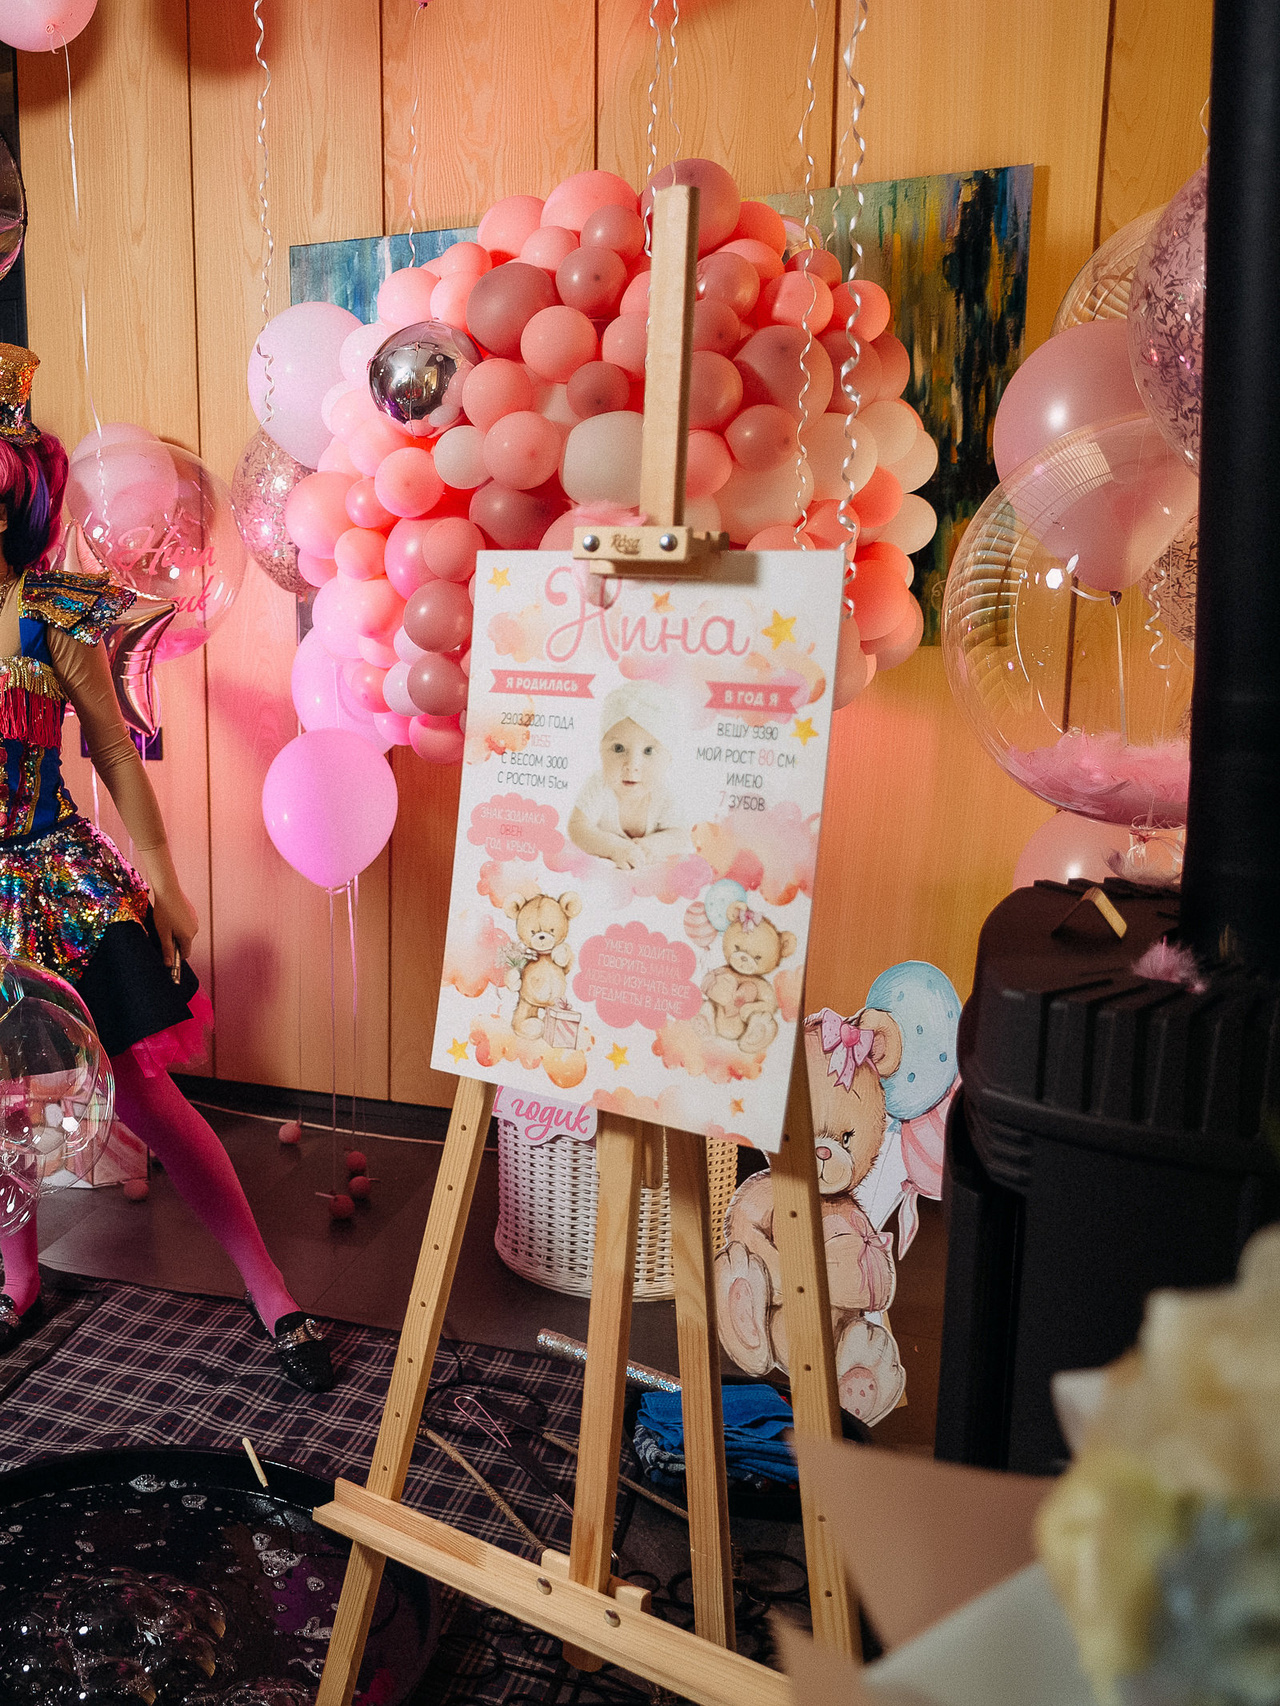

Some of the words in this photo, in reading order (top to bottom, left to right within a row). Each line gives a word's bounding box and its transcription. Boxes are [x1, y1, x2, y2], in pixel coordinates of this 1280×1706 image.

[544, 565, 751, 663] Нина
[505, 677, 515, 689] Я
[515, 677, 579, 693] РОДИЛАСЬ
[724, 689, 734, 705] В
[736, 690, 765, 707] ГОД
[768, 692, 780, 707] Я
[548, 715, 575, 730] ГОДА
[716, 722, 750, 738] ВЕШУ
[752, 725, 779, 741] 9390
[500, 752, 508, 765] С
[510, 752, 544, 768] ВЕСОМ
[546, 755, 569, 770] 3000
[696, 746, 722, 761] МОЙ
[724, 748, 756, 765] РОСТ
[776, 752, 796, 769] СМ
[497, 770, 505, 784] С
[506, 771, 547, 788] РОСТОМ
[725, 772, 764, 789] ИМЕЮ
[720, 790, 727, 807] 7
[728, 794, 767, 812] ЗУБОВ
[480, 806, 504, 820] ЗНАК
[504, 808, 547, 825] ЗОДИАКА
[499, 823, 523, 837] ОВЕН
[485, 836, 502, 851] ГОД
[506, 839, 537, 855] КРЫСЫ
[605, 938, 634, 955] УМЕЮ
[637, 943, 679, 963] ХОДИТЬ
[597, 953, 648, 975] ГОВОРИТЬ
[623, 975, 670, 996] ИЗУЧАТЬ
[671, 982, 692, 999] ВСЕ
[587, 984, 643, 1007] ПРЕДМЕТЫ
[644, 995, 653, 1009] В
[653, 999, 683, 1015] ДОМЕ
[510, 1098, 591, 1141] годик
